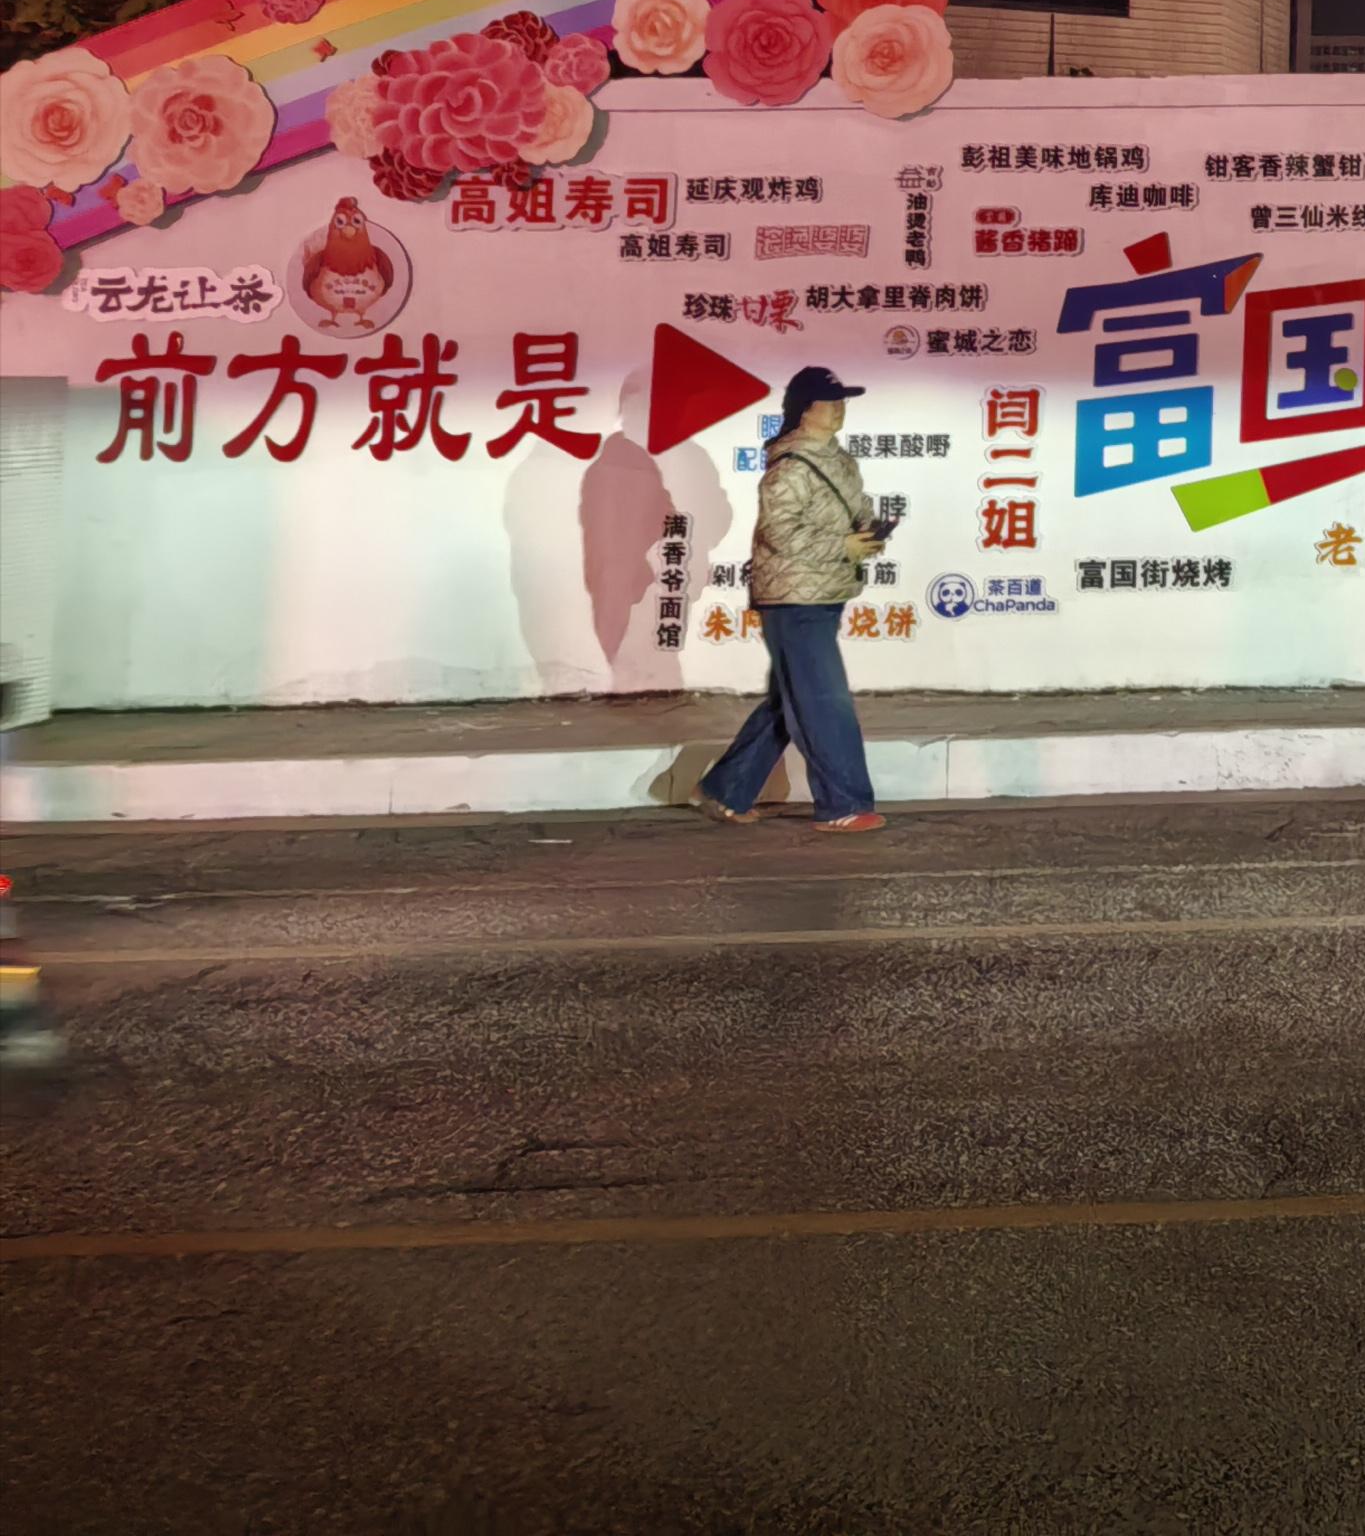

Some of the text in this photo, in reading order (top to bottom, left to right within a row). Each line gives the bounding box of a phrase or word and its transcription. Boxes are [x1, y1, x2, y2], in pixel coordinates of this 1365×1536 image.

[961, 146, 1144, 168] 彭祖美味地锅鸡
[1206, 154, 1362, 177] 钳客香辣蟹钳
[451, 176, 668, 224] 高姐寿司
[686, 177, 819, 201] 延庆观炸鸡
[1089, 184, 1194, 207] 库迪咖啡
[620, 234, 726, 258] 高姐寿司
[806, 284, 983, 309] 胡大拿里脊肉饼
[927, 330, 1032, 353] 蜜城之恋
[96, 331, 602, 463] 前方就是
[980, 389, 1041, 550] 闫二姐
[657, 514, 688, 647] 满香爷面馆
[1079, 560, 1232, 589] 富国街烧烤
[989, 579, 1042, 596] 茶百道
[974, 598, 1055, 613] ChaPanda
